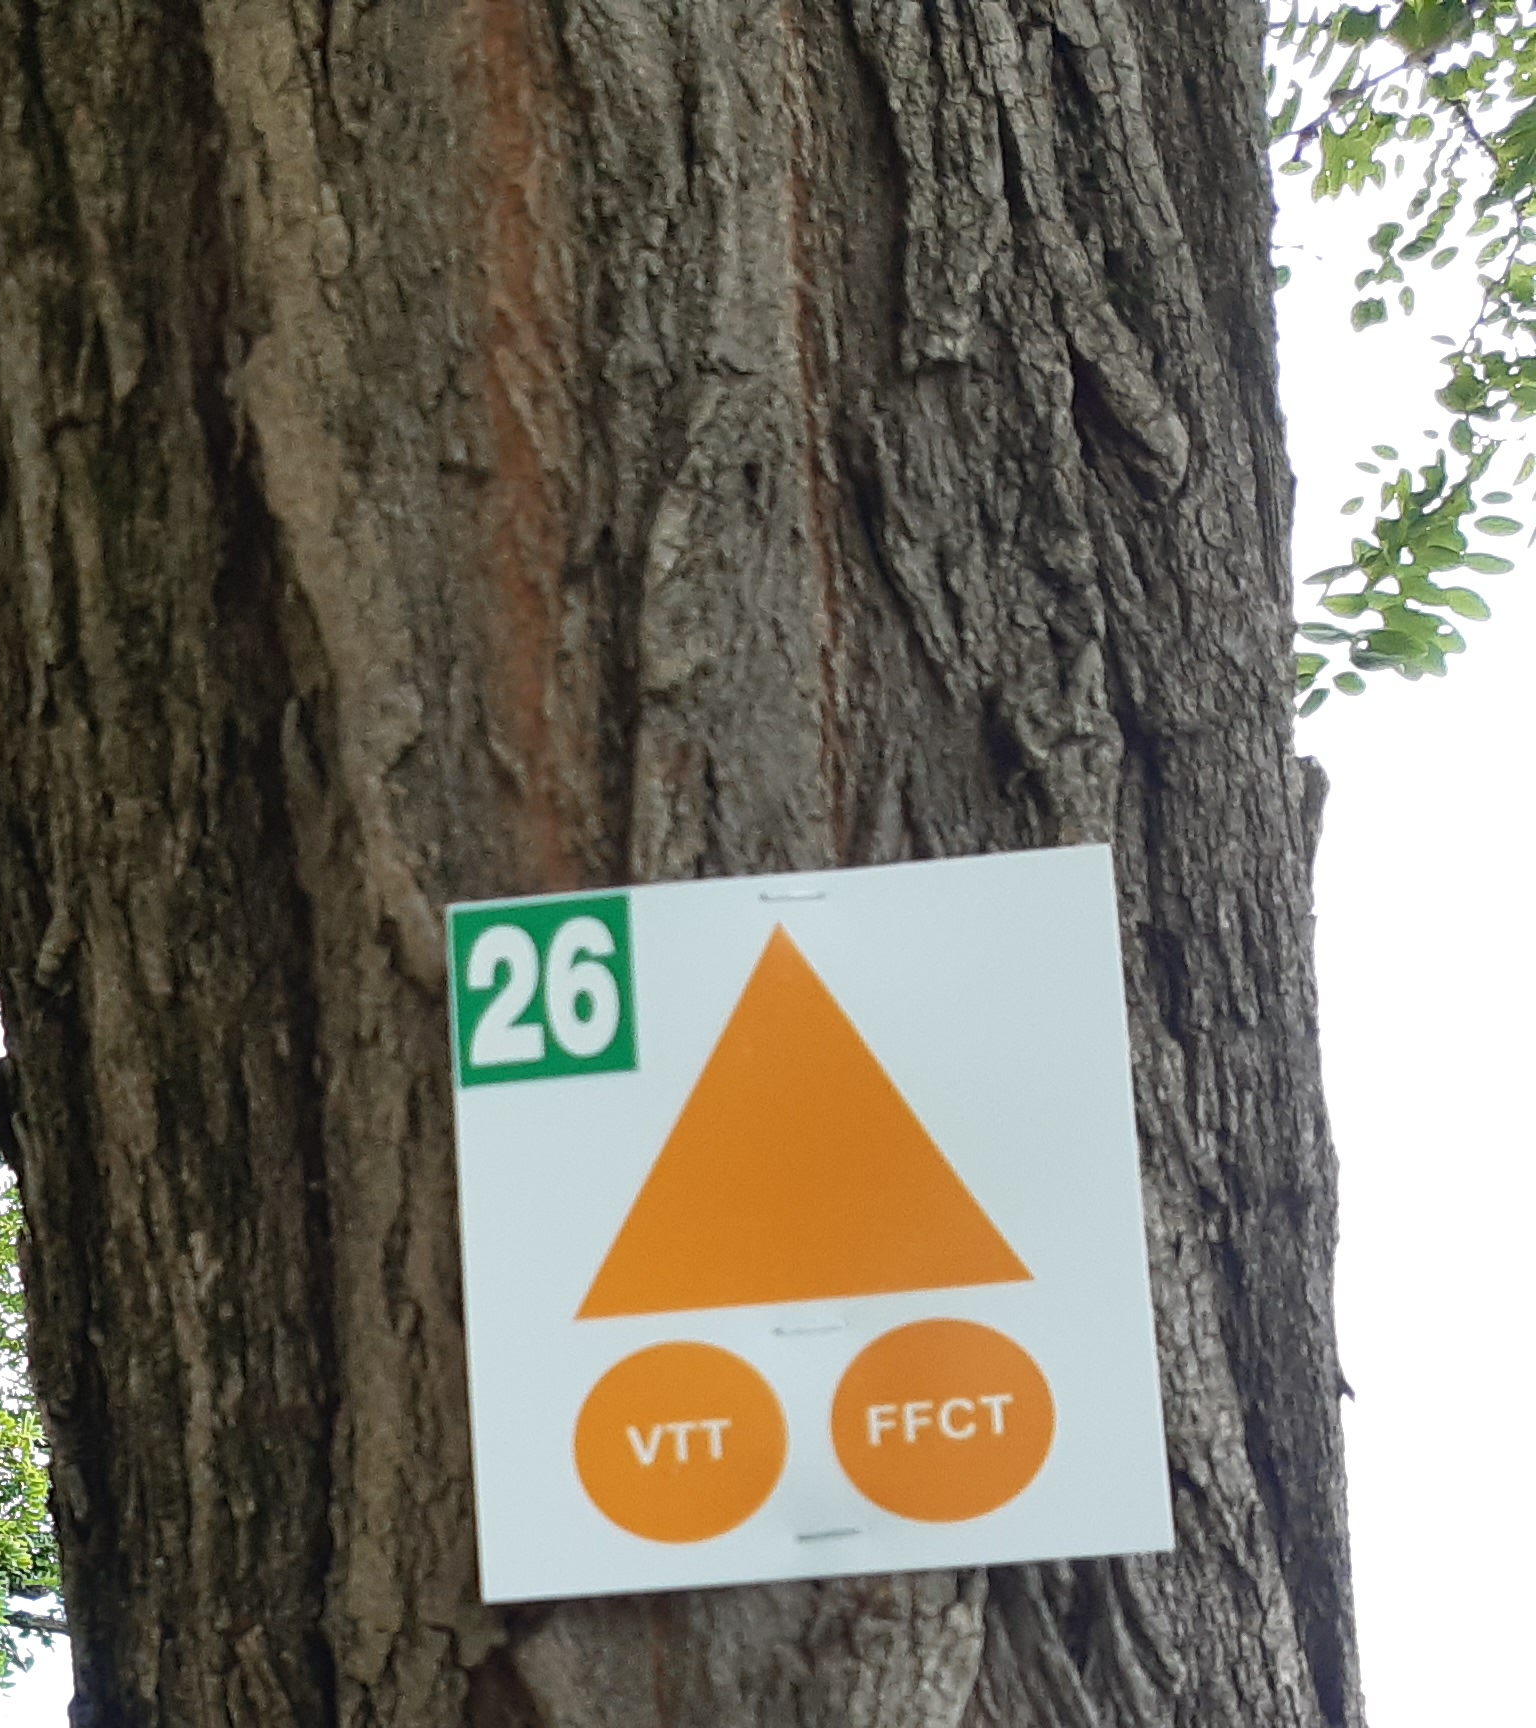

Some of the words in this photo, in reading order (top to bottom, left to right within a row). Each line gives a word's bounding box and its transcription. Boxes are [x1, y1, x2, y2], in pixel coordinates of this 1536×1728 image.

[467, 915, 620, 1067] 26
[626, 1417, 732, 1466] VTT
[865, 1393, 1014, 1446] FFCT
